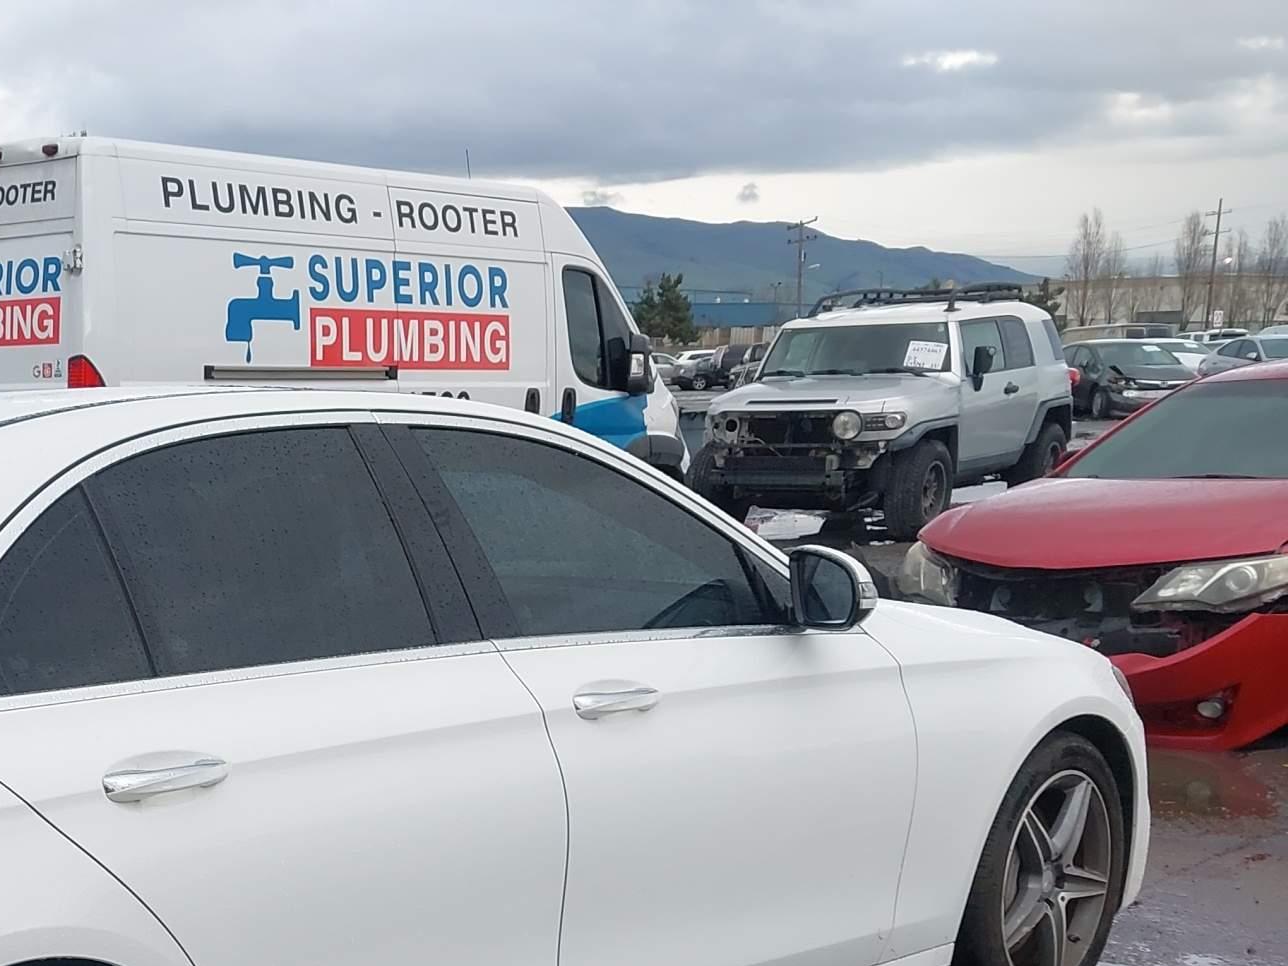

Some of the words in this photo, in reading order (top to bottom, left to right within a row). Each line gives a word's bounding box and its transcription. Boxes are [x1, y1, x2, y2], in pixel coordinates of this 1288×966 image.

[161, 176, 358, 224] PLUMBING
[395, 200, 519, 238] ROOTER
[308, 254, 509, 308] SUPERIOR
[315, 315, 507, 364] PLUMBING
